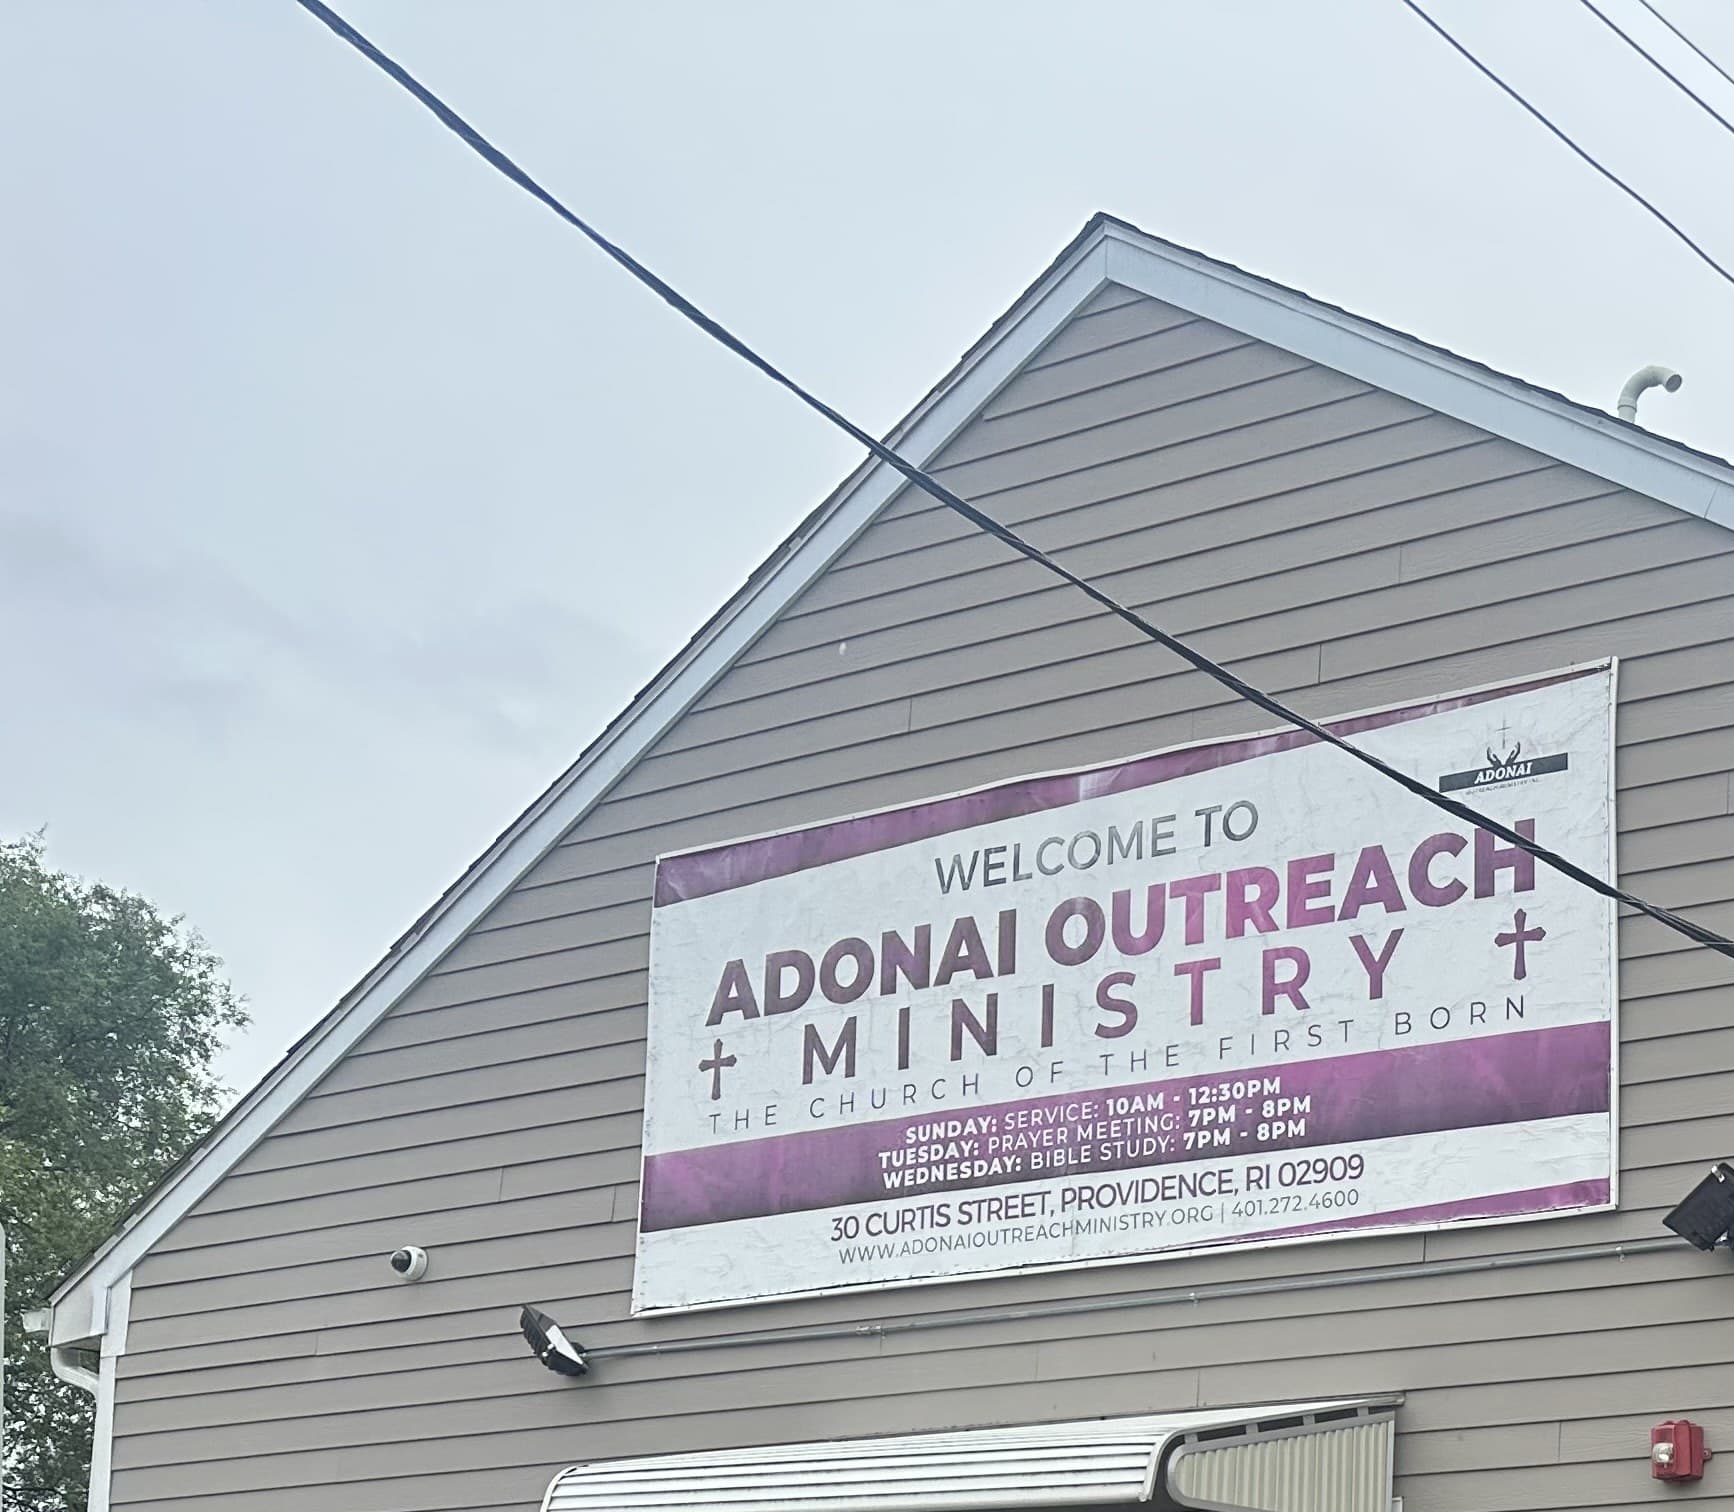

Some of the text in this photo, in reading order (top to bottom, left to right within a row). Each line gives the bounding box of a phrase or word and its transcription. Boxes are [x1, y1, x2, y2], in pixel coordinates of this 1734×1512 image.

[1474, 762, 1534, 784] ADONAI
[934, 800, 1259, 894] WELCOME TO
[705, 818, 1536, 1028] ADONAI OUTREACH
[802, 928, 1405, 1086] MINISTRY
[709, 995, 1524, 1135] THE CHURCH OF THE FIRST BORN
[878, 1140, 979, 1169] TUESDAY:
[988, 1127, 1068, 1154] PRAYER
[1077, 1113, 1180, 1142] MEETING:
[1188, 1105, 1236, 1128] 7PM
[1261, 1095, 1311, 1118] 8PM
[906, 1115, 997, 1145] SUNDAY:
[1004, 1101, 1099, 1130] SERVICE:
[1106, 1092, 1164, 1117] 10AM
[1188, 1076, 1281, 1105] 12:30PM
[883, 1154, 1022, 1190] WEDNESDAY:
[1030, 1145, 1092, 1170] BIBLE
[1100, 1135, 1175, 1161] STUDY:
[1183, 1127, 1231, 1151] 7PM
[1256, 1118, 1306, 1142] 8PM
[831, 1154, 1365, 1242] 30 CURTIS STREET, PROVIDENCE, RI 02909
[838, 1204, 1214, 1265] WWW.ADONAIOUTREACHMINISTRY.ORG
[1231, 1188, 1360, 1218] 401.272.4600
